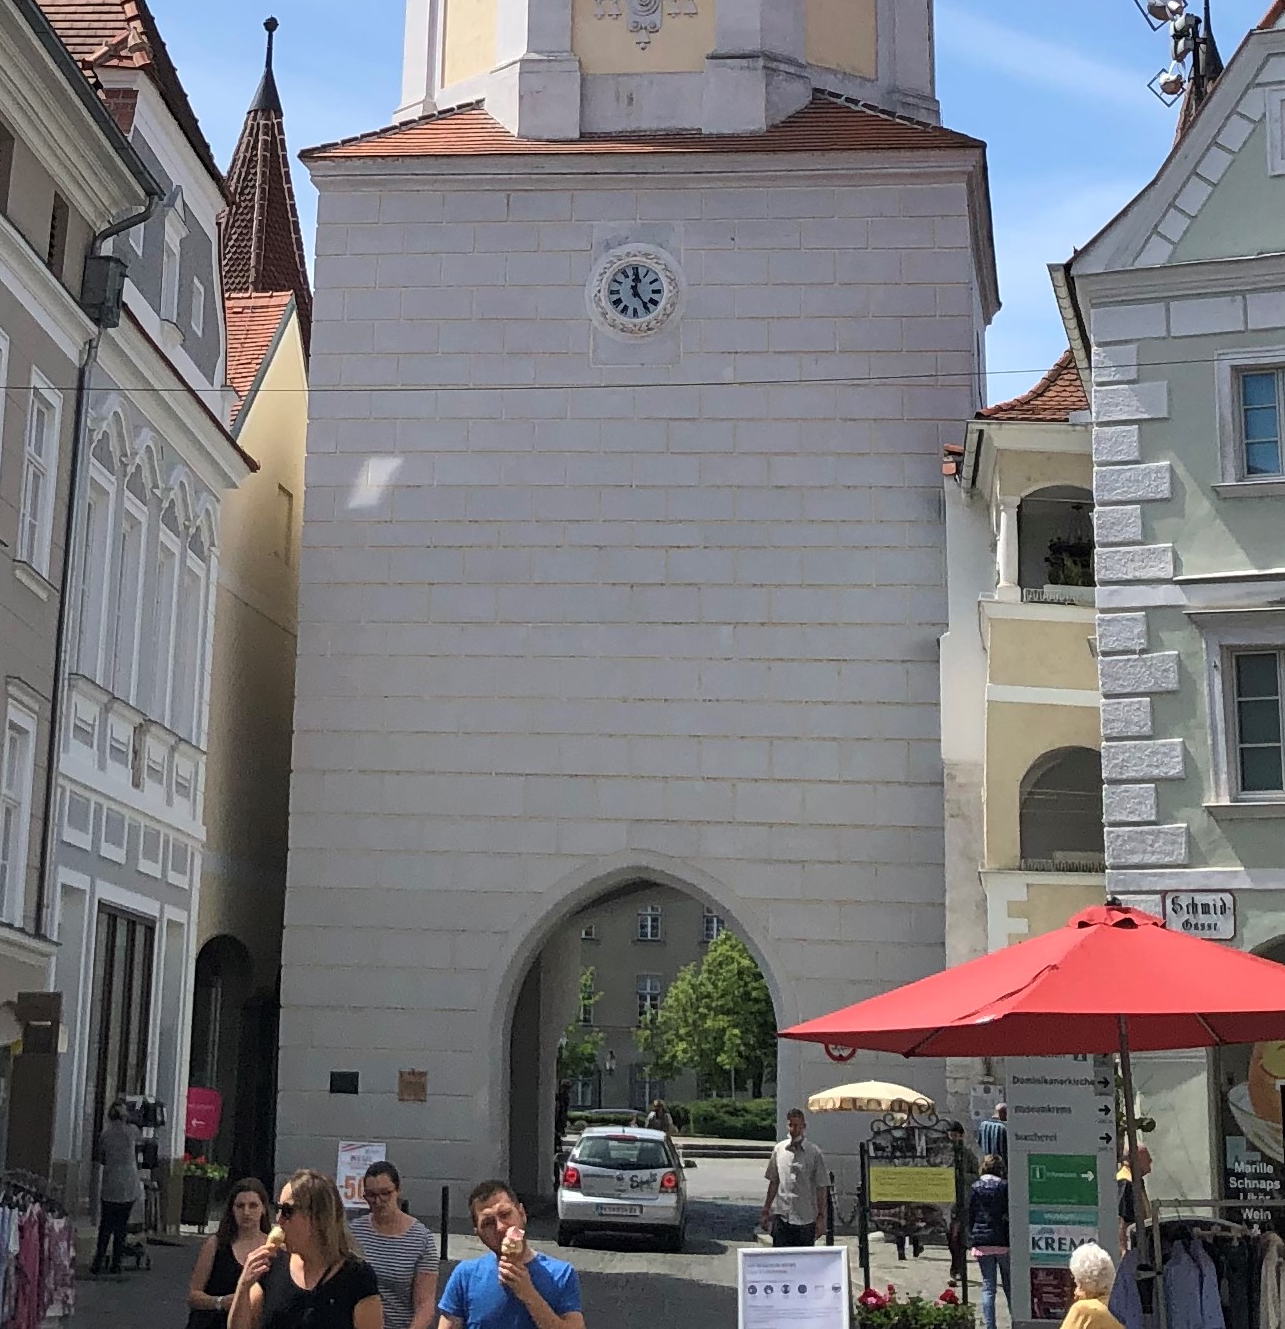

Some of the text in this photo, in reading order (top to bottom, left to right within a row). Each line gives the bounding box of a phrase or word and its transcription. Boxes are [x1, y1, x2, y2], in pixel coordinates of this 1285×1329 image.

[1234, 1161, 1274, 1174] Marille
[1229, 1176, 1281, 1191] Schnaps
[1241, 1208, 1272, 1220] Wein
